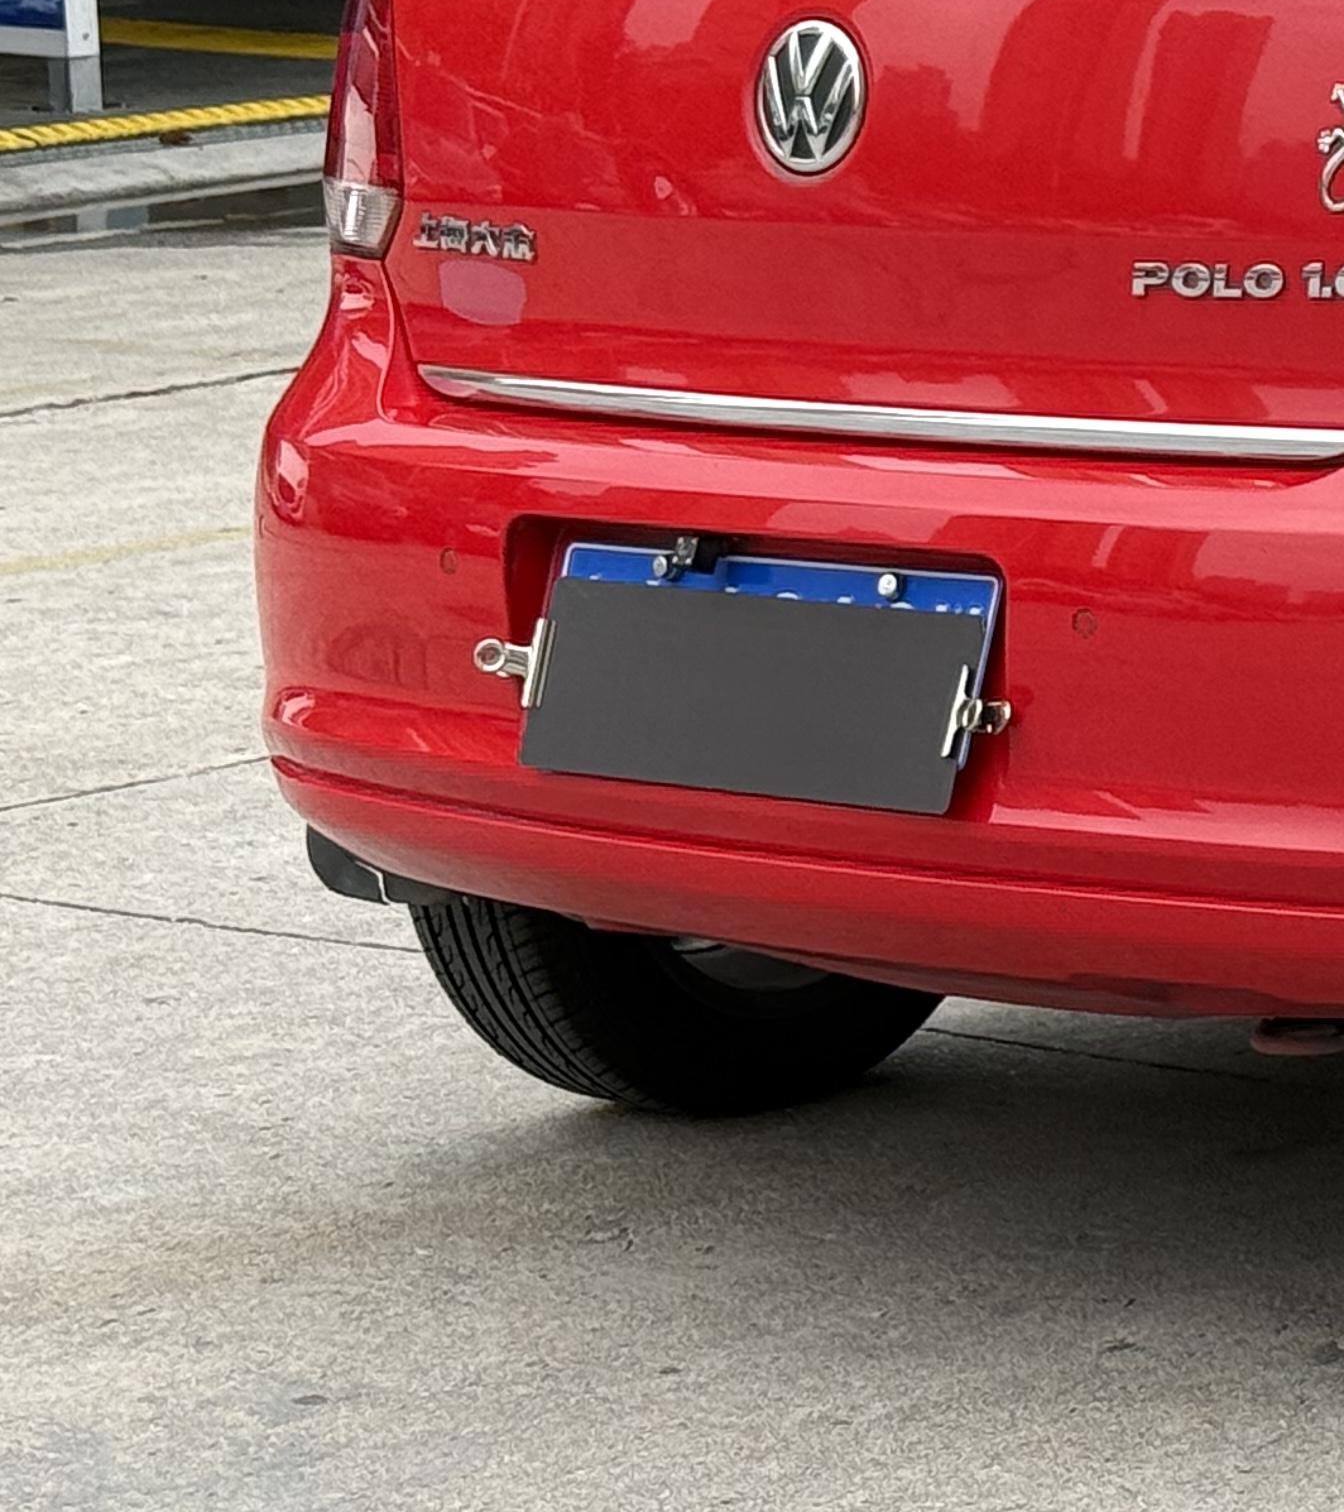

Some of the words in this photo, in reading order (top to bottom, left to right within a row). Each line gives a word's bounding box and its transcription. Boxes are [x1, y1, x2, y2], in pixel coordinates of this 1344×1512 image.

[412, 212, 536, 261] 上海大众
[1131, 261, 1284, 299] POLO
